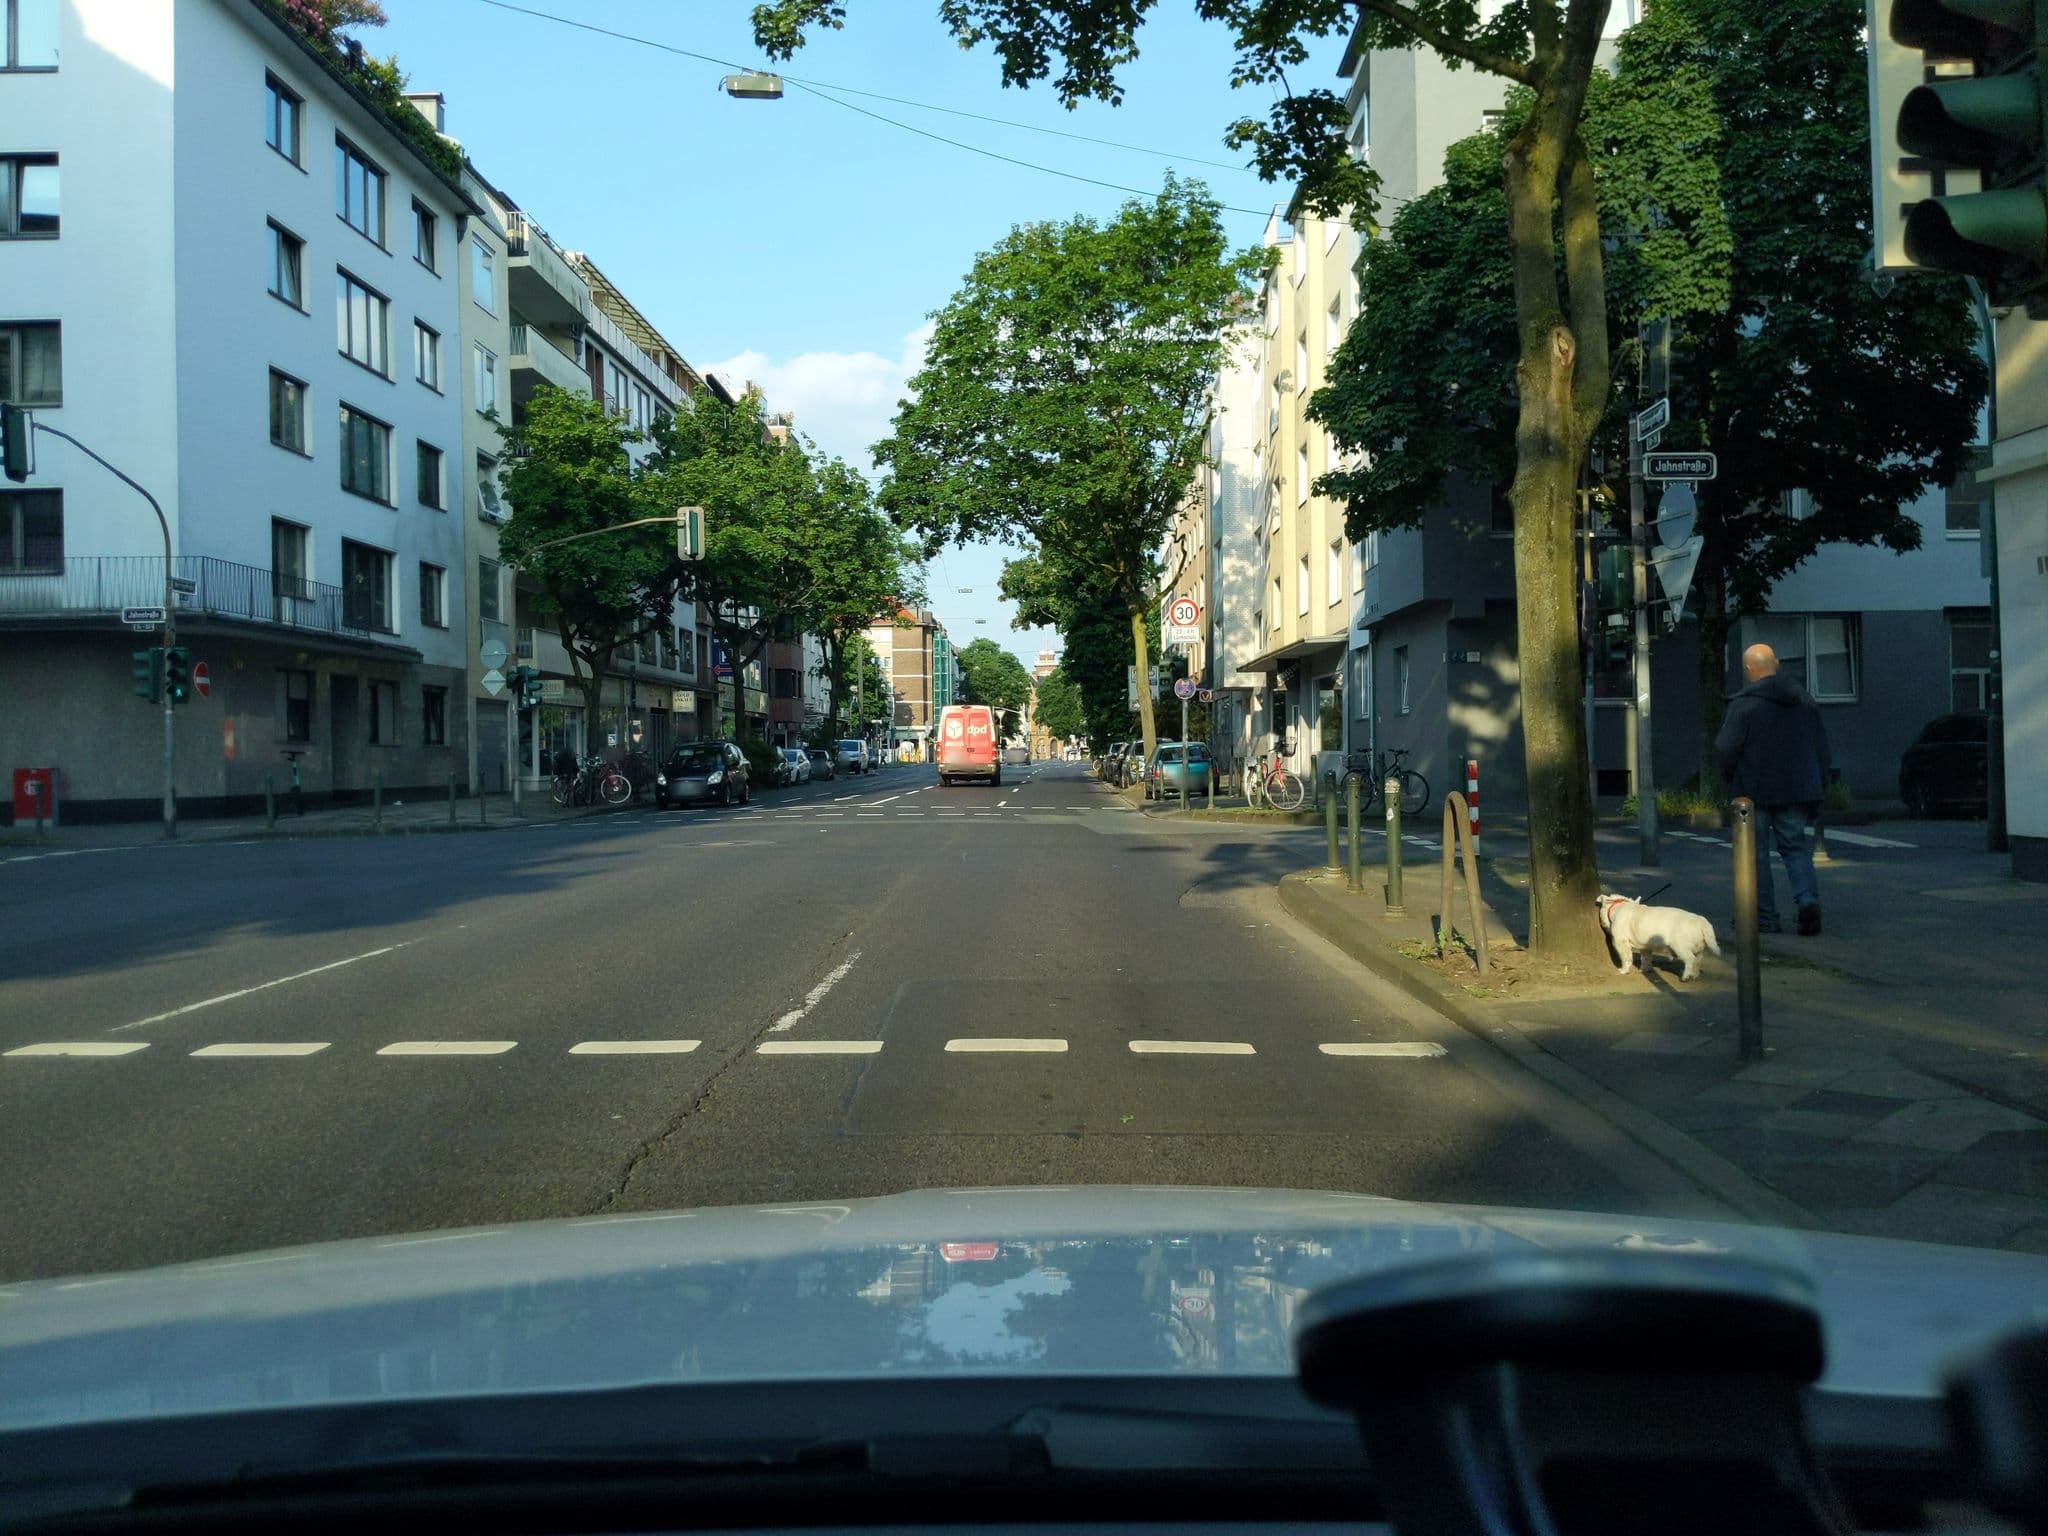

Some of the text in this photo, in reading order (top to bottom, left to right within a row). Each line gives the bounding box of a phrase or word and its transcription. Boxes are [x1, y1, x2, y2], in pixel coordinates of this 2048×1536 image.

[1655, 460, 1707, 473] Jahnstraße
[1176, 607, 1193, 620] 30
[967, 724, 987, 736] dpd
